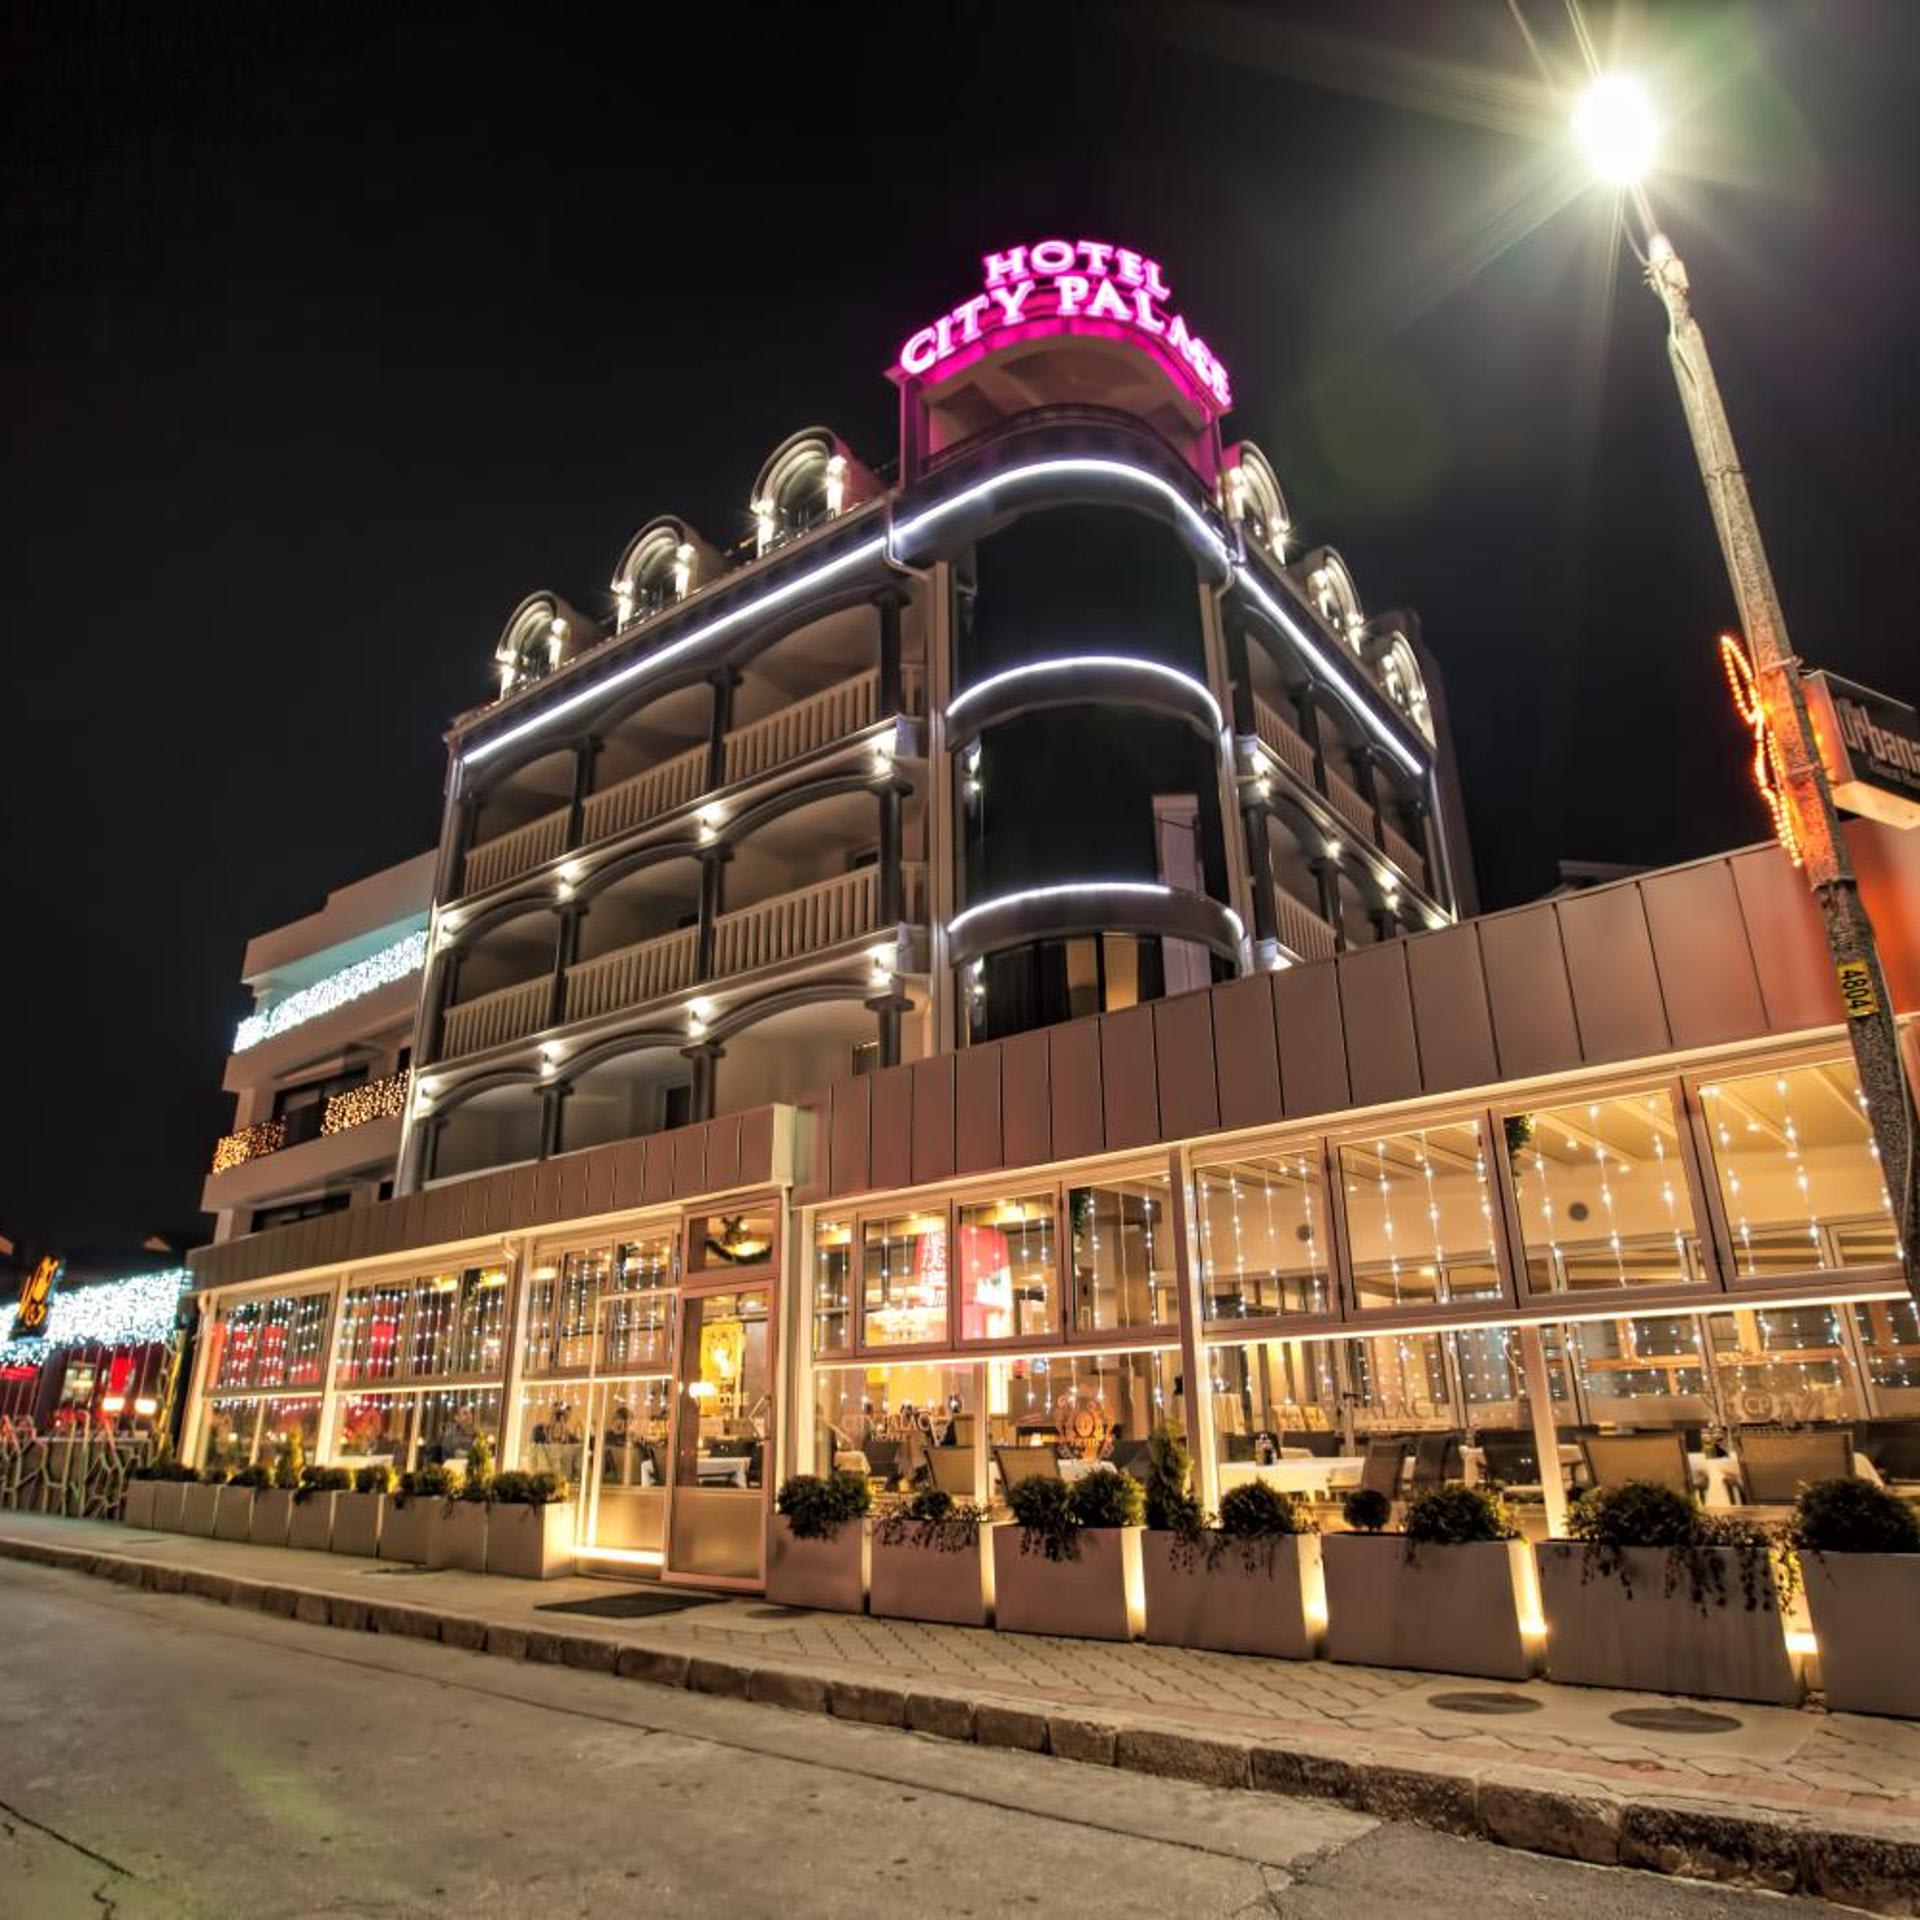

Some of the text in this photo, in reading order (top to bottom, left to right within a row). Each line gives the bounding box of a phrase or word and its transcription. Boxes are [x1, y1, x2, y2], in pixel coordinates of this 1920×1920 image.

[983, 240, 1170, 301] HOTEL
[901, 275, 1231, 406] CITY PALACE
[1840, 969, 1872, 1009] 4804
